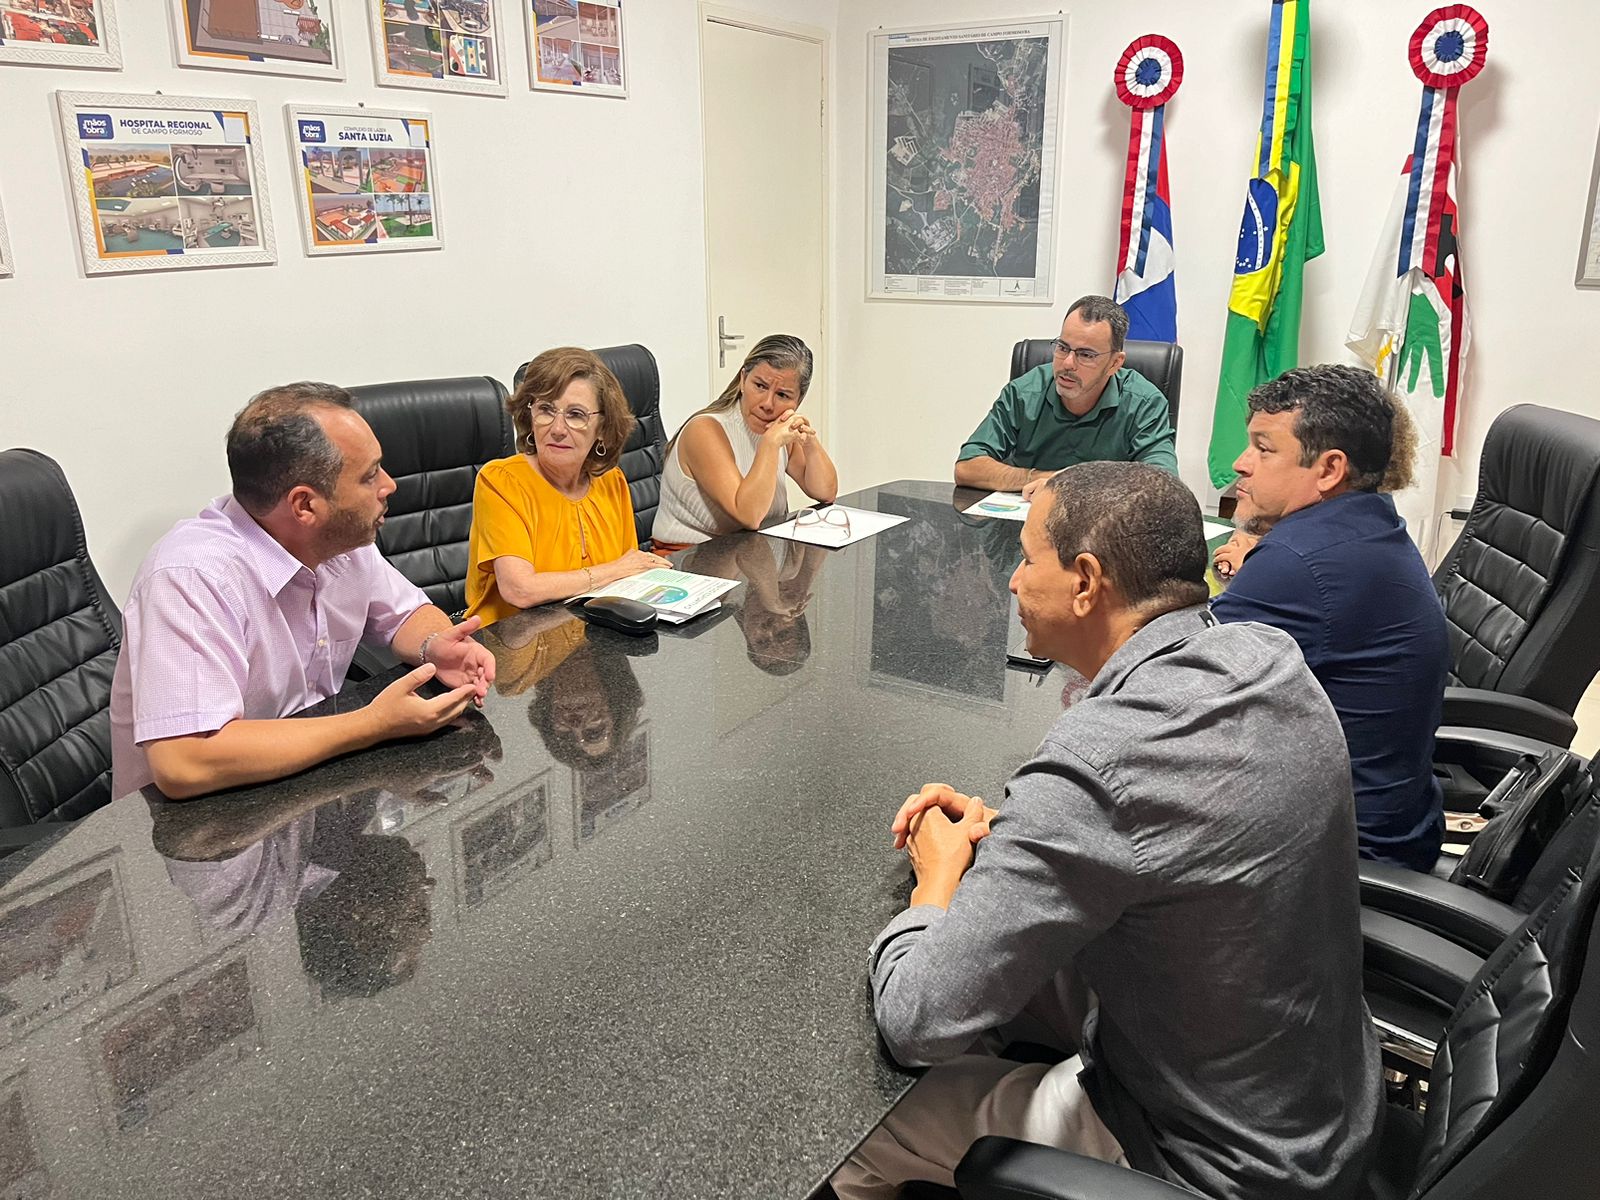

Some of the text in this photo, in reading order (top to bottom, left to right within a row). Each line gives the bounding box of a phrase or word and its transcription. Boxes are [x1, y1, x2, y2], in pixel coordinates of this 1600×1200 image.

[120, 119, 212, 129] HOSPITAL REGIONAL
[169, 128, 203, 136] FORMOSO
[338, 131, 393, 142] SANTA LUZIA
